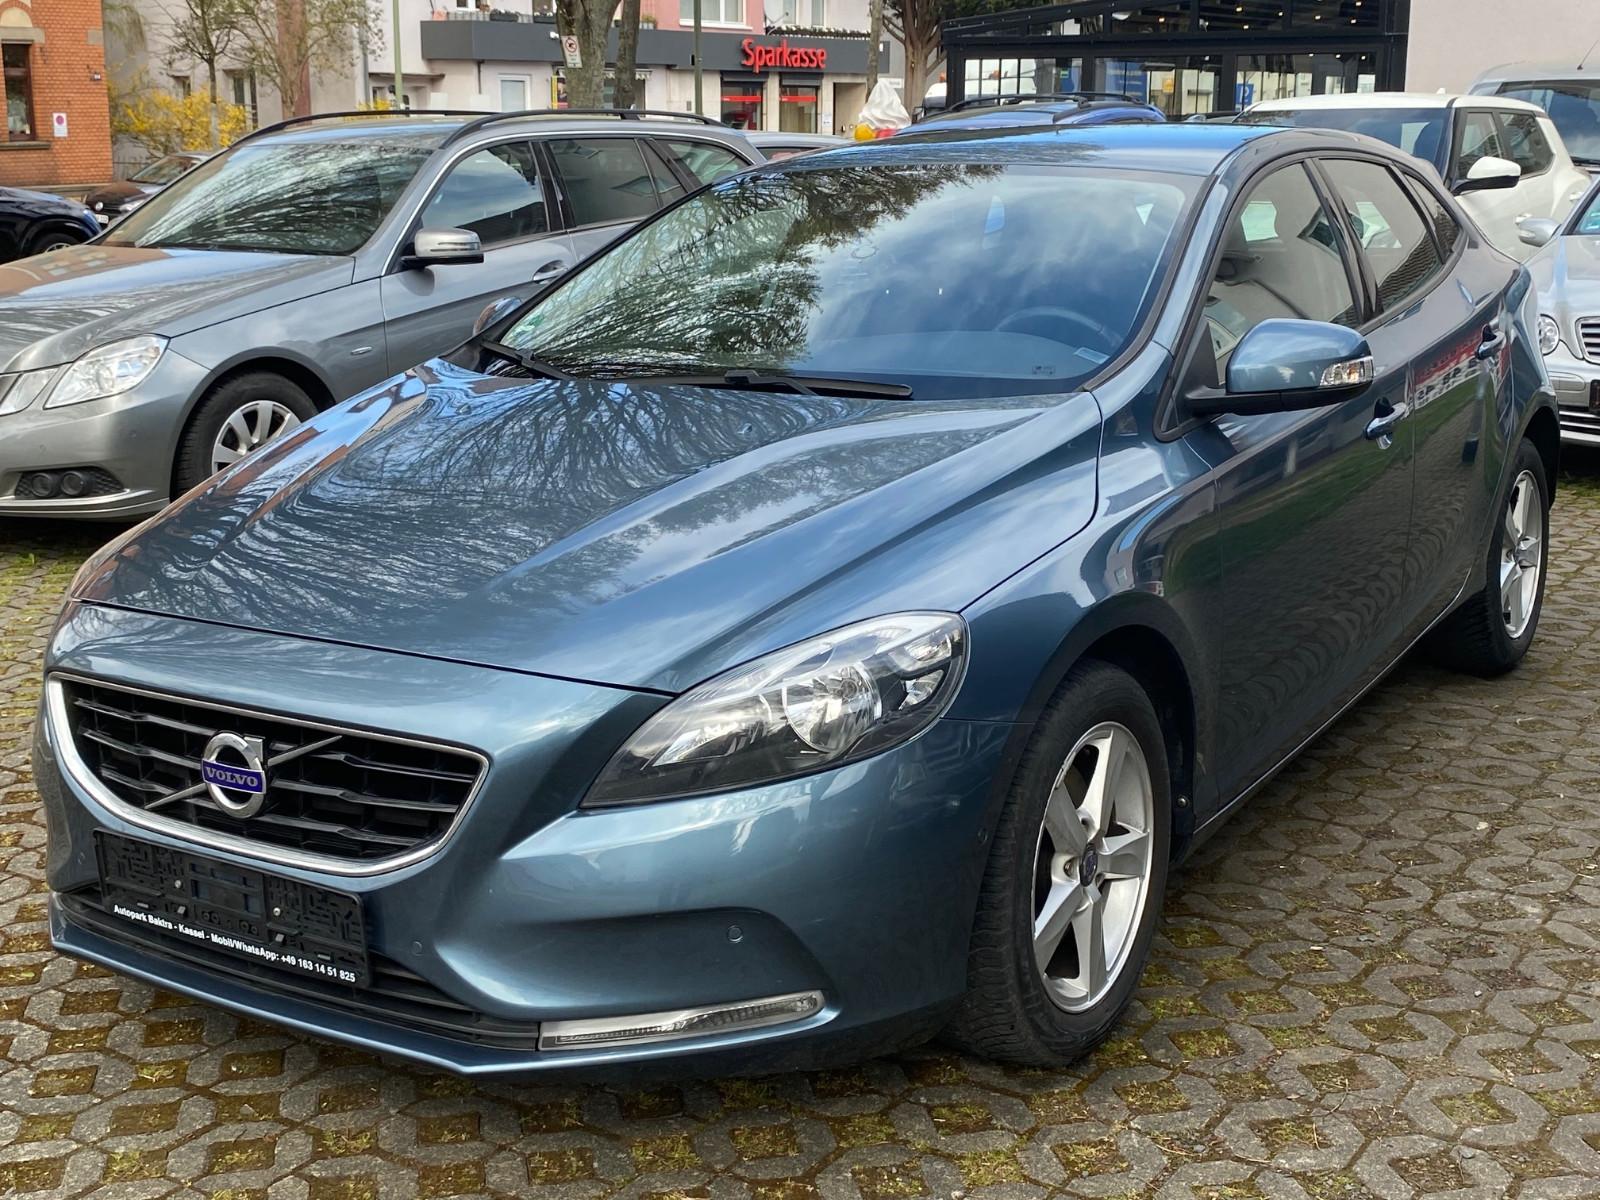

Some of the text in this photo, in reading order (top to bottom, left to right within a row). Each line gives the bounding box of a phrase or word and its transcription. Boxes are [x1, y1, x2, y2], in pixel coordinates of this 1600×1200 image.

[741, 37, 827, 74] Sparkasse
[205, 766, 259, 787] VOLVO
[114, 904, 147, 922] Autopark
[178, 924, 205, 939] Kassel
[211, 933, 280, 962] Mobil/WhatsApp:
[281, 955, 297, 965] +49
[298, 958, 314, 971] 163
[314, 963, 326, 974] 14
[327, 966, 338, 977] 51
[339, 970, 356, 982] 825
